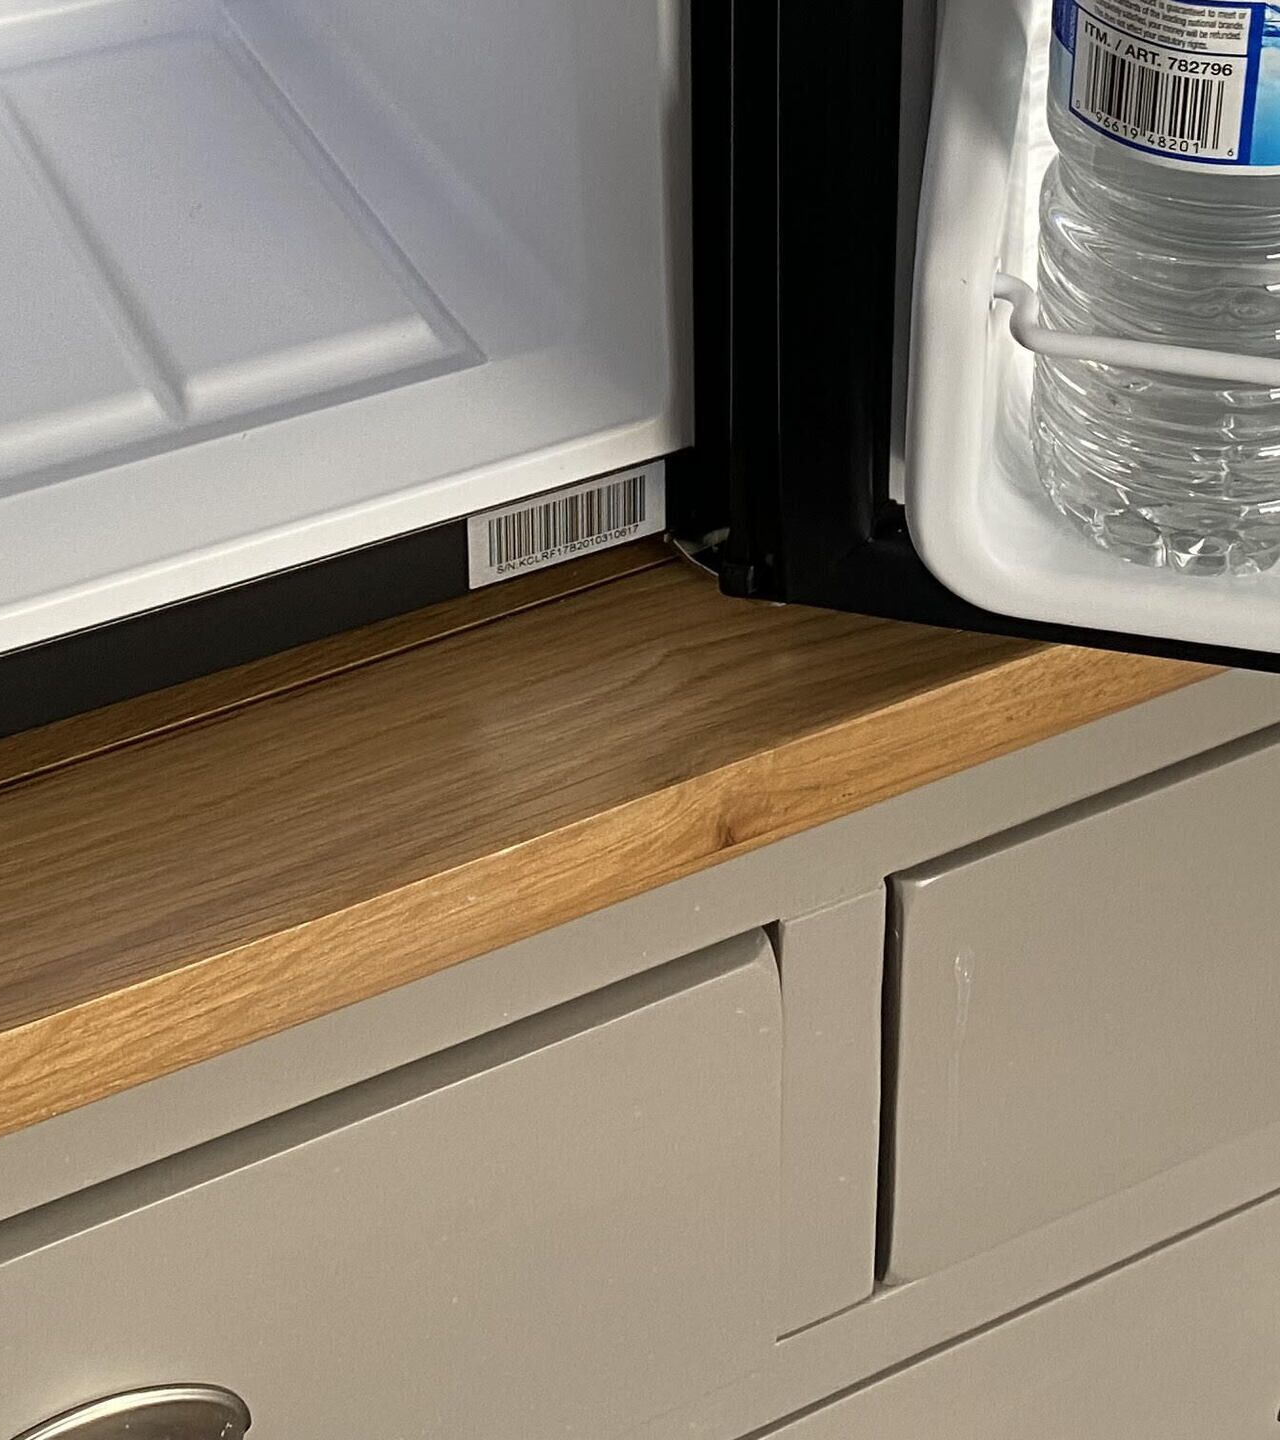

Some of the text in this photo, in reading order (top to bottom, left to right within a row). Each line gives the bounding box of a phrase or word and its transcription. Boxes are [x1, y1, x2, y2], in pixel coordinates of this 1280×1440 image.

[1084, 20, 1233, 76] ITM. / ART. 782796
[1095, 111, 1139, 140] 96619
[1147, 134, 1200, 154] 48201
[1227, 148, 1234, 157] 6
